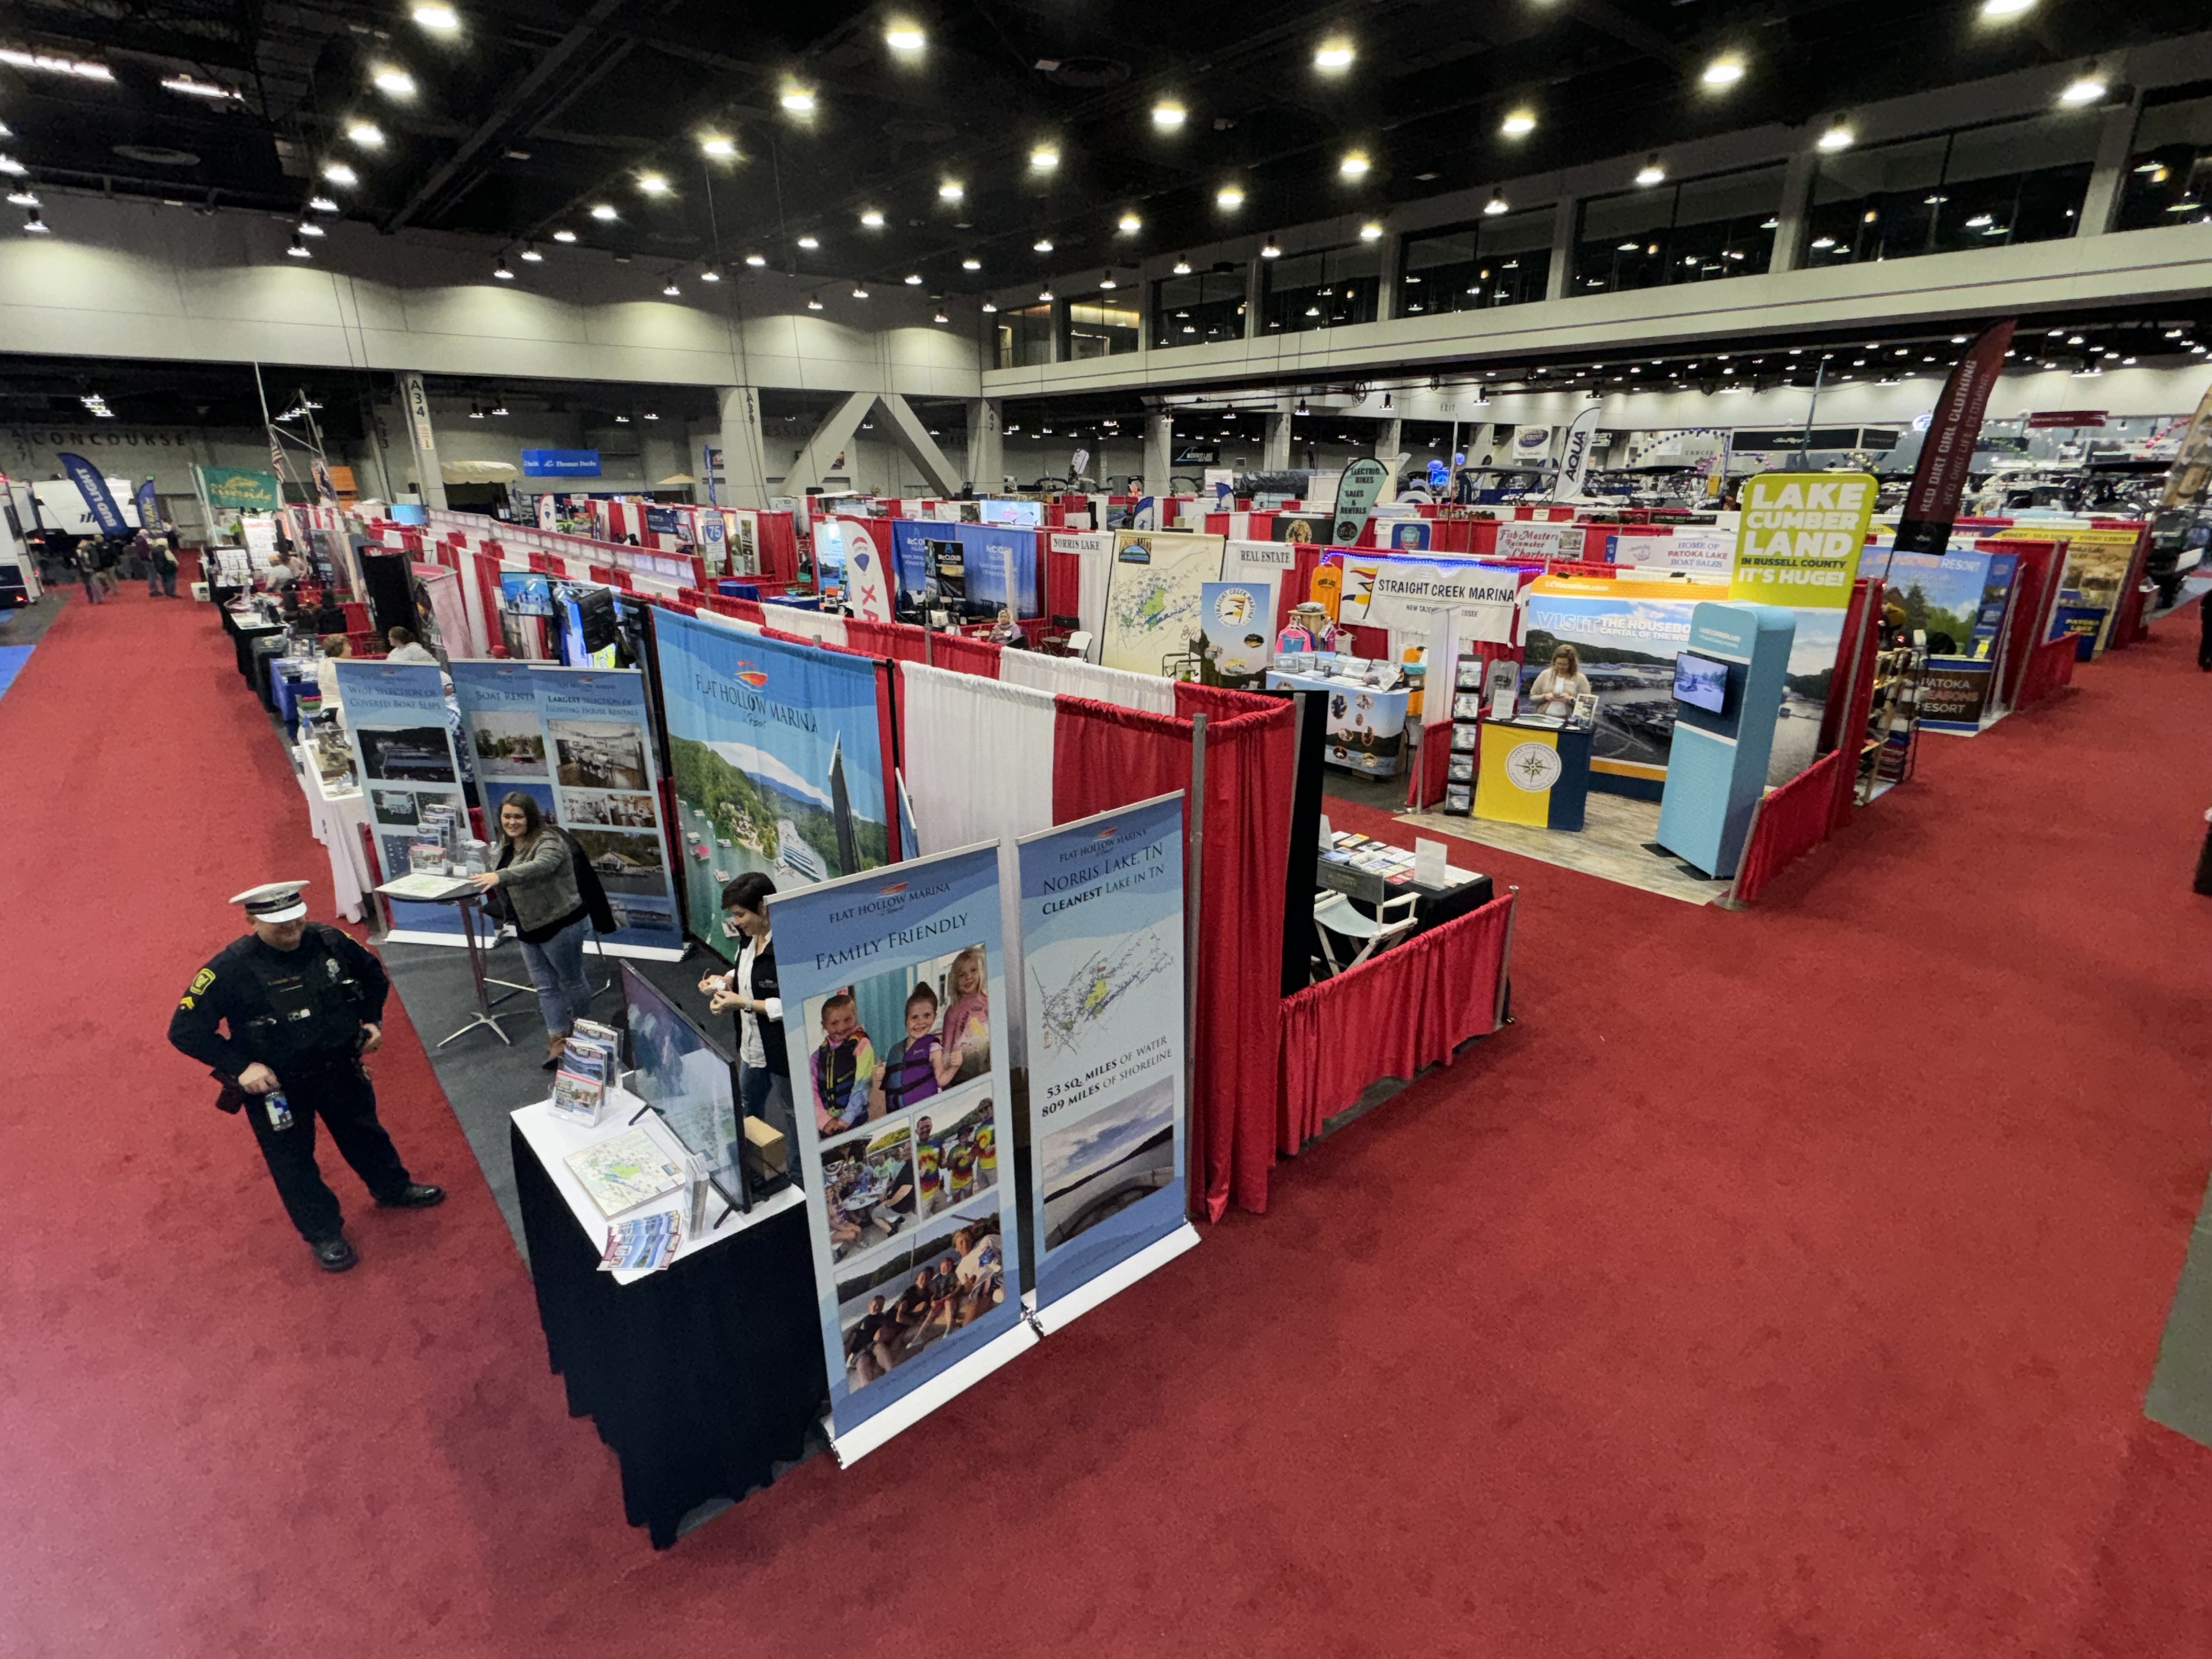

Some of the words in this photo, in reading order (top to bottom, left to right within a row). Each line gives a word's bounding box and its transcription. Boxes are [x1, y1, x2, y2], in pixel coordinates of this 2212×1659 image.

[31, 432, 185, 446] CONCOURSE
[1921, 488, 1936, 512] RED
[1929, 457, 1947, 486] DIRT
[1938, 425, 1956, 453] GIRL
[1949, 359, 1977, 421] CLOTHING
[1565, 431, 1587, 483] AQUA
[1751, 483, 1866, 510] LAKE
[1746, 511, 1860, 530] CUMBER
[708, 526, 721, 538] 75
[1499, 529, 1517, 540] Fish
[1519, 530, 1559, 541] Masters
[1053, 538, 1079, 549] NORRIS
[1081, 540, 1100, 550] LAKE
[1505, 539, 1545, 549] Rainmaker
[1512, 548, 1554, 558] Charters
[1743, 531, 1853, 558] LAND
[1240, 550, 1260, 562] REAL
[1261, 551, 1290, 563] ESTATE
[1706, 551, 1728, 560] LAKE
[1741, 557, 1752, 566] IN
[1753, 558, 1798, 567] RUSSELL
[1801, 560, 1847, 569] COUNTY
[1940, 558, 1982, 572] RESORT
[1738, 567, 1775, 584] IT'S
[1779, 570, 1846, 587] HUGE!
[1378, 579, 1430, 595] STRAIGHT
[1431, 584, 1466, 599] CREEK
[1469, 587, 1514, 602] MARINA
[1462, 610, 1479, 618] ESSEE
[1536, 611, 1601, 634] VISIT
[1601, 617, 1627, 628] THE
[1628, 620, 1691, 634] HOUSEBO
[1600, 627, 1638, 637] CAPITAL
[1652, 632, 1671, 640] THE
[476, 690, 500, 702] BOAT
[548, 695, 580, 704] LARGEST
[696, 673, 719, 698] FLAT
[720, 684, 767, 715] HOLLOW
[770, 703, 819, 734] MARINA
[1059, 851, 1078, 863] FLAT
[1080, 839, 1115, 857] HOLLOW
[1116, 828, 1147, 844] MARINA
[1043, 866, 1099, 895] NORRIS
[1143, 842, 1163, 861] TN
[1042, 887, 1103, 915] CLEANEST
[1106, 877, 1131, 894] LAKE
[1135, 871, 1146, 884] IN
[1148, 864, 1165, 878] TN
[829, 909, 855, 924] FLAT
[858, 895, 908, 917] HOLLOW
[909, 883, 951, 901] MARINA
[816, 938, 882, 971] FAMILY
[888, 912, 968, 949] FRIENDLY
[1047, 1084, 1061, 1099] 53
[1064, 1077, 1083, 1091] SQ.
[1085, 1059, 1117, 1082] MILES
[1120, 1052, 1133, 1065] OF
[1136, 1035, 1167, 1057] WATER
[1042, 1099, 1065, 1117] 809
[1068, 1082, 1100, 1107] MILES
[1103, 1077, 1117, 1089] OF
[1119, 1048, 1172, 1081] SHORELINE
